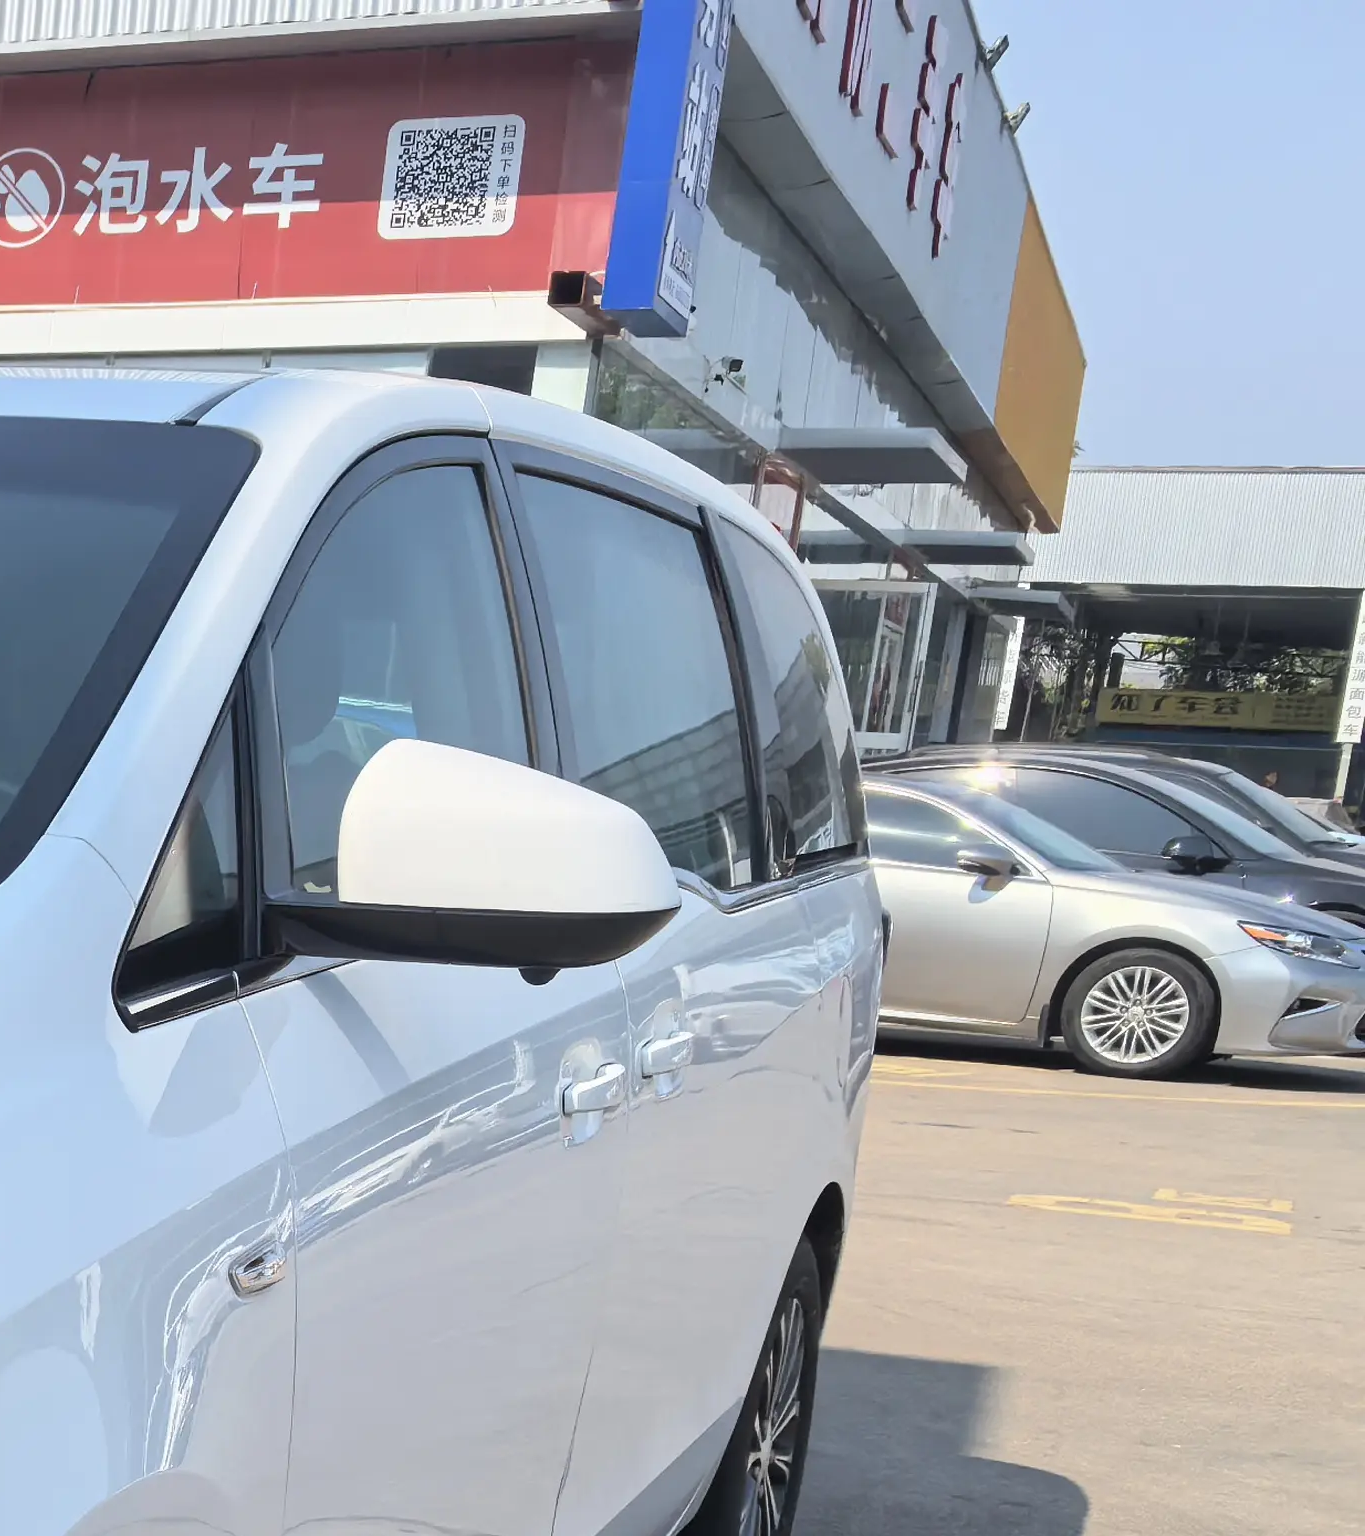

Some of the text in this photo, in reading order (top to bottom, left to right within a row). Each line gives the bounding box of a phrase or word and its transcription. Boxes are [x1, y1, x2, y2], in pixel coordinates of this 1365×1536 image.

[72, 142, 325, 235] 泡水车
[491, 124, 517, 223] 扫码下单检测
